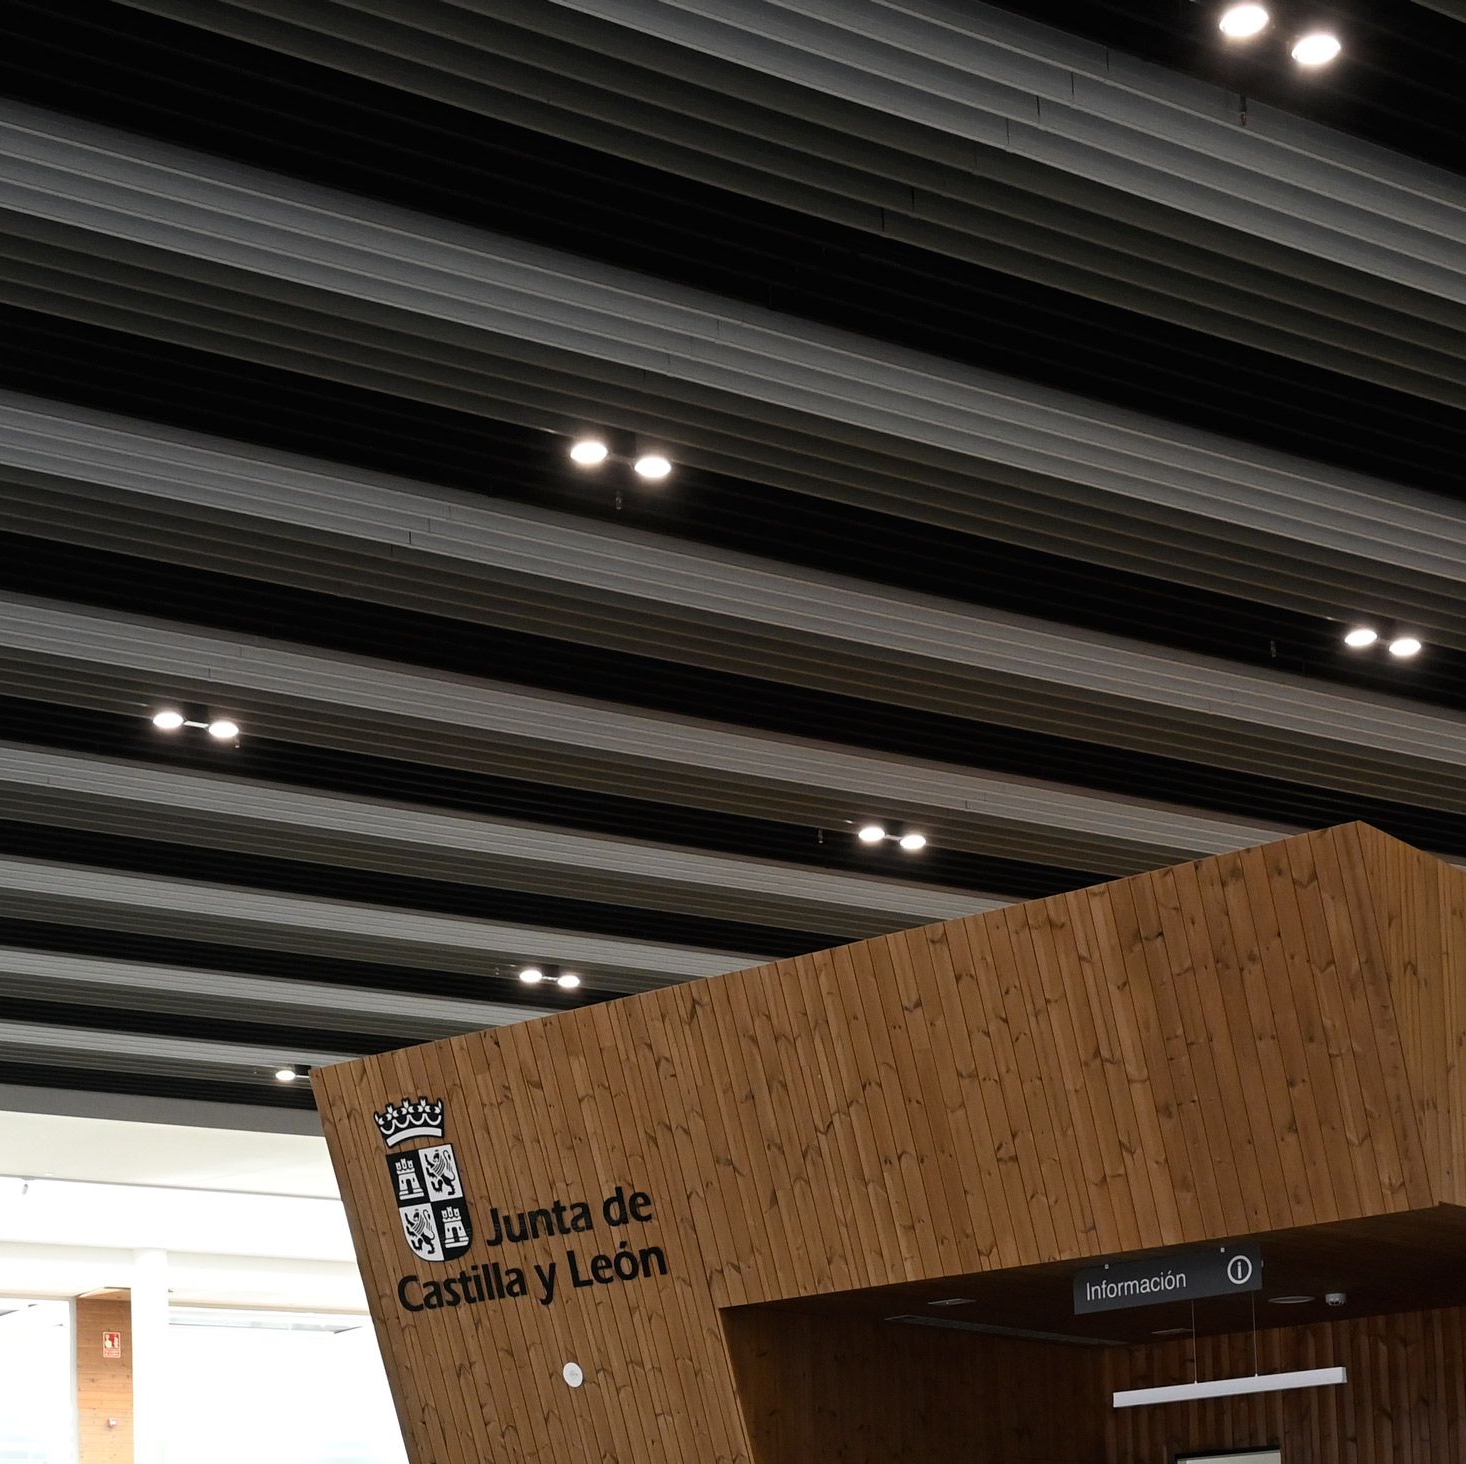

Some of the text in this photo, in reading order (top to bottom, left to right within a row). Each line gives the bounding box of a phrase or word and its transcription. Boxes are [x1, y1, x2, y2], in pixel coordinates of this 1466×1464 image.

[486, 1186, 653, 1246] Junta de
[397, 1241, 667, 1312] Castilla y León
[1086, 1270, 1187, 1301] Información
